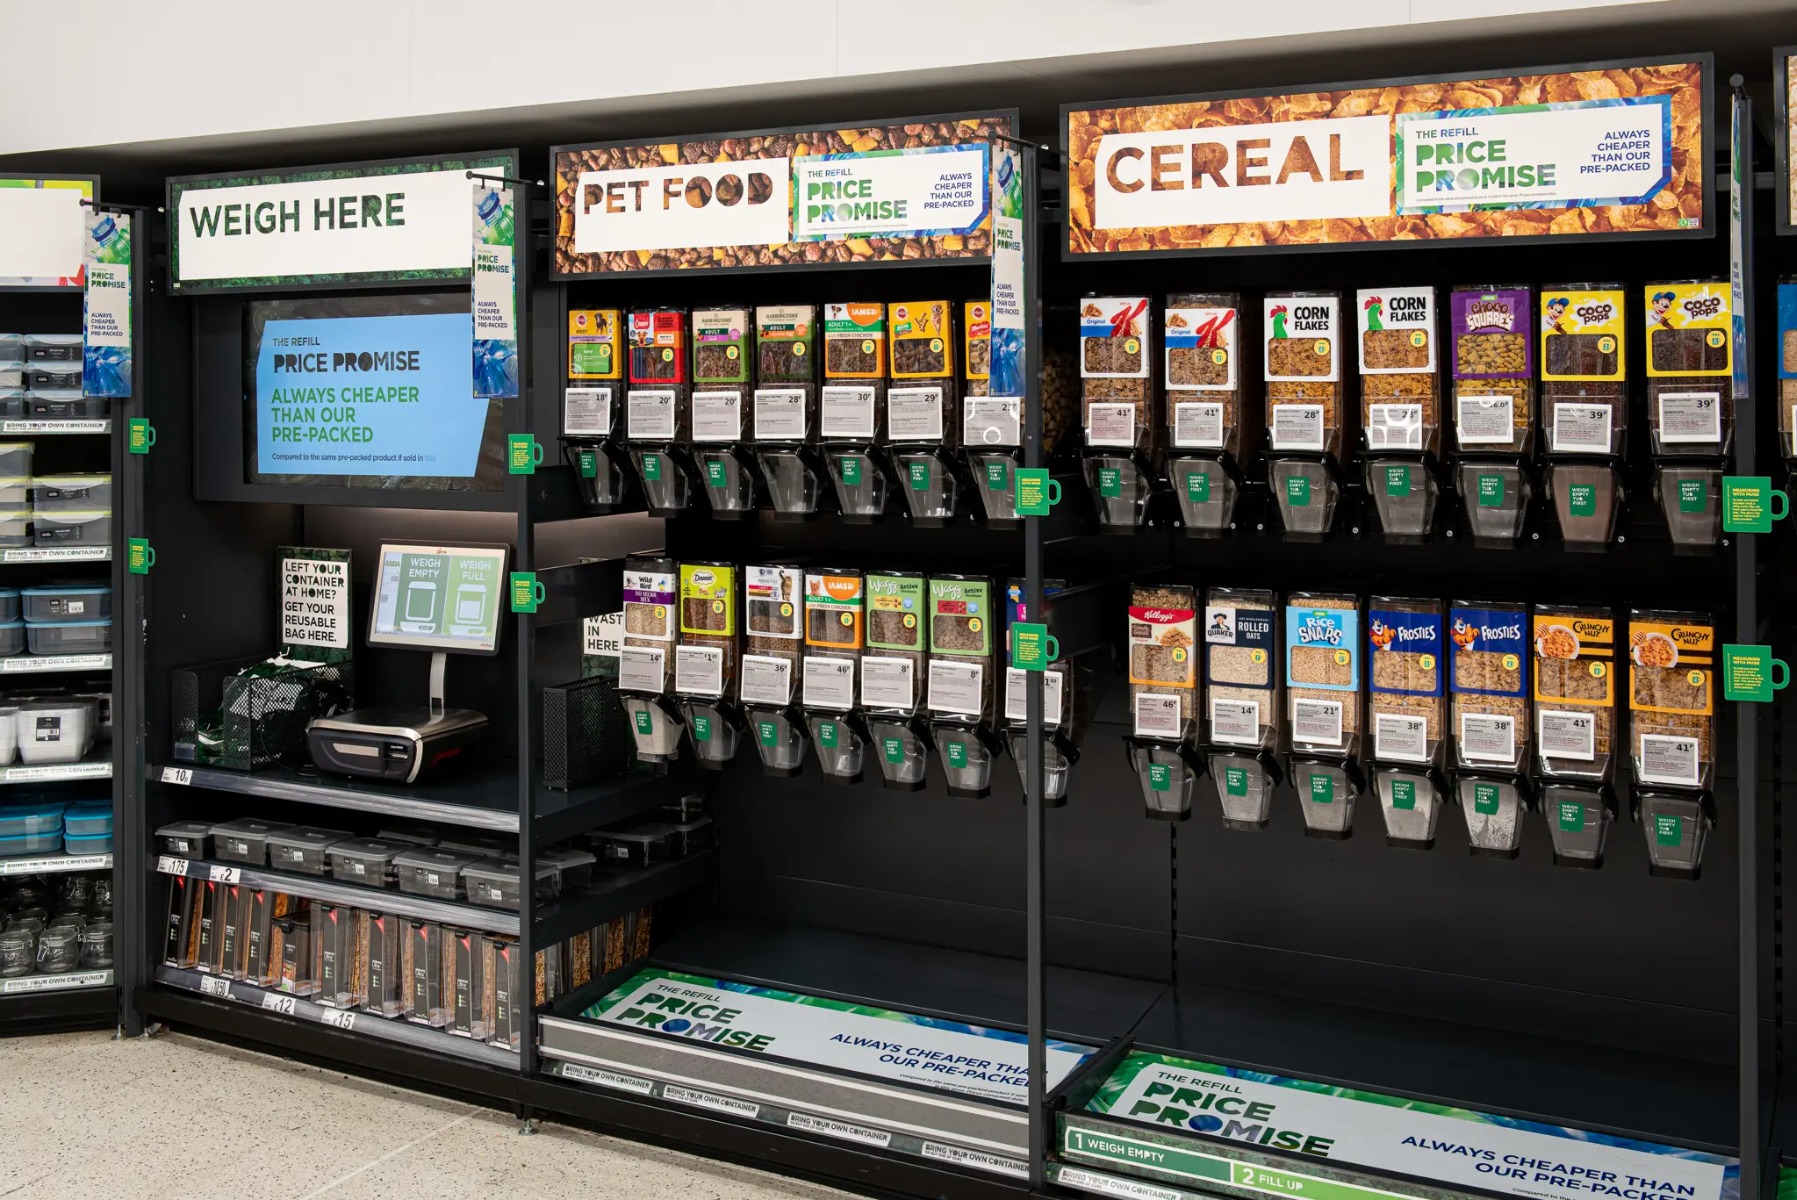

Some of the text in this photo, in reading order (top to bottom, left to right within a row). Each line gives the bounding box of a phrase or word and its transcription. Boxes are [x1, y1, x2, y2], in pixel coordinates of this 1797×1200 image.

[1415, 127, 1478, 139] THE REFILL
[1604, 129, 1650, 140] ALWAYS
[1416, 139, 1507, 166] PRICE
[1597, 140, 1650, 152] CHEAPER
[1106, 133, 1364, 193] CEREAL
[1591, 151, 1650, 163] THAN OUR
[807, 168, 852, 178] THE REFILL
[1580, 162, 1650, 175] PRE-PACKED
[939, 172, 972, 182] ALWAYS
[1416, 164, 1556, 193] PROMISE
[807, 179, 873, 201] PRICE
[934, 181, 972, 191] CHEAPER
[584, 172, 773, 215] PET FOOD
[930, 190, 972, 200] THAN OUR
[924, 199, 974, 210] PRE-PACKED
[189, 192, 406, 238] WEIGH HERE
[807, 200, 907, 224] PROMISE
[477, 254, 499, 264] PRICE
[477, 263, 510, 274] PROMISE
[91, 272, 115, 281] PRICE
[91, 280, 126, 289] PROMISE
[1389, 296, 1426, 311] CORN
[1294, 306, 1330, 320] CORN
[1390, 311, 1426, 322] FLAKES
[477, 321, 508, 329] PRE-PACKED
[1294, 321, 1329, 331] FLAKES
[1465, 311, 1515, 331] SQUARES
[272, 337, 320, 347] THE REFILL
[274, 350, 420, 373] PRICE PROMISE
[271, 386, 420, 404] ALWAYS CHEAPER
[271, 407, 356, 423] THAN OUR
[272, 426, 374, 443] PRE-PACKED
[272, 453, 302, 462] Compared
[303, 453, 309, 461] to
[310, 453, 320, 461] the
[338, 454, 372, 462] pre-packed
[372, 454, 396, 463] product
[397, 454, 402, 462] if
[403, 454, 416, 462] sold
[417, 454, 423, 462] in
[285, 562, 342, 575] LEFT YOUR
[410, 558, 441, 568] WEIGH
[460, 559, 491, 570] WEIGH
[409, 568, 440, 579] EMPTY
[462, 571, 485, 581] FULL
[285, 574, 344, 588] CONTAINER
[869, 578, 899, 594] Wagg
[285, 587, 337, 600] AT HOME?
[932, 583, 963, 600] Wagg
[284, 601, 335, 615] GET YOUR
[284, 614, 336, 629] REUSABLE
[1144, 610, 1174, 622] Kellogg's
[1305, 616, 1335, 629] Rice
[587, 625, 600, 637] IN
[1207, 629, 1234, 639] QUAKER
[1238, 621, 1269, 633] ROLLED
[1397, 624, 1436, 642] FROSTIES
[1481, 624, 1521, 641] FROSTIES
[1572, 620, 1610, 634] CRUNCHY
[1584, 630, 1600, 638] NUT
[284, 628, 337, 642] BAG HERE.
[1246, 631, 1261, 640] OATS
[1297, 626, 1343, 645] SNAPS
[587, 639, 622, 652] HERE.
[175, 769, 189, 784] 10p
[220, 867, 232, 882] £2
[657, 984, 721, 1003] THE REFILL
[274, 999, 293, 1012] £12
[635, 992, 742, 1025] PRICE
[332, 1012, 351, 1028] £15
[615, 1007, 776, 1052] PROMISE
[830, 1033, 1030, 1076] ALWAYS CHEAPER THA
[565, 1064, 650, 1091] BRING YOUR OWN CONTAINER
[879, 1054, 920, 1068] OUR
[921, 1062, 1030, 1088] PRE-PACKE
[1158, 1071, 1243, 1095] THE REFILL
[1143, 1081, 1276, 1122] PRICE
[1128, 1099, 1336, 1157] PROMISE
[1075, 1132, 1165, 1163] 1 WEIGH EMPTY
[1401, 1135, 1497, 1161] ALWAYS
[1502, 1154, 1619, 1182] CHEAPER
[1624, 1175, 1696, 1197] THAN
[1475, 1162, 1528, 1181] OUR
[1242, 1167, 1304, 1191] 2 FILL UP
